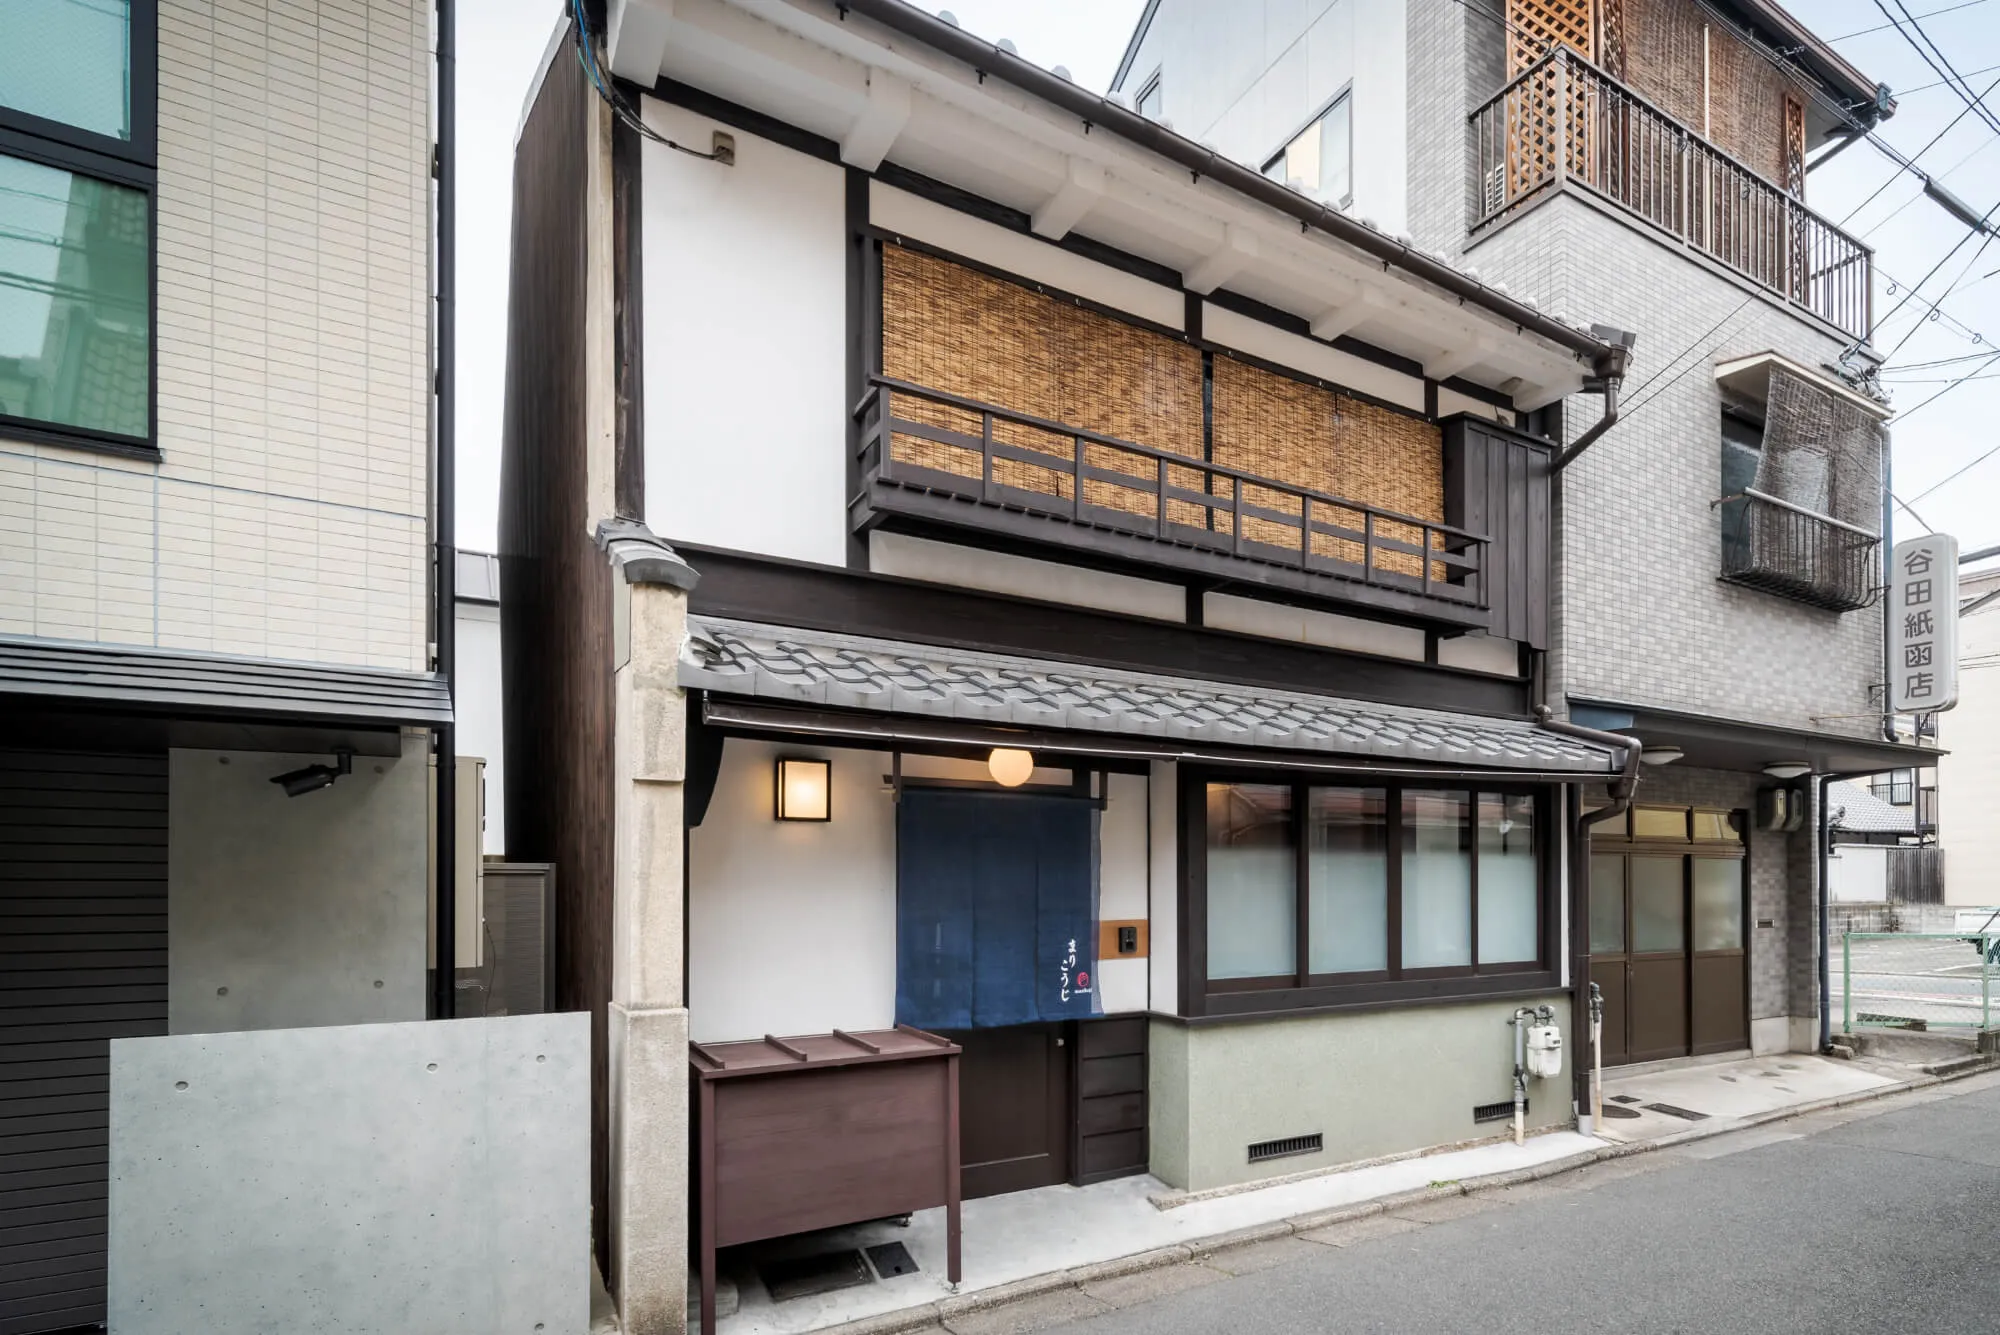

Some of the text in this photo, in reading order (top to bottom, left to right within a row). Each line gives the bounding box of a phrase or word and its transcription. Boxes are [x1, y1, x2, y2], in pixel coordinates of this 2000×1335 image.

[1904, 548, 1934, 699] 谷田紙函店
